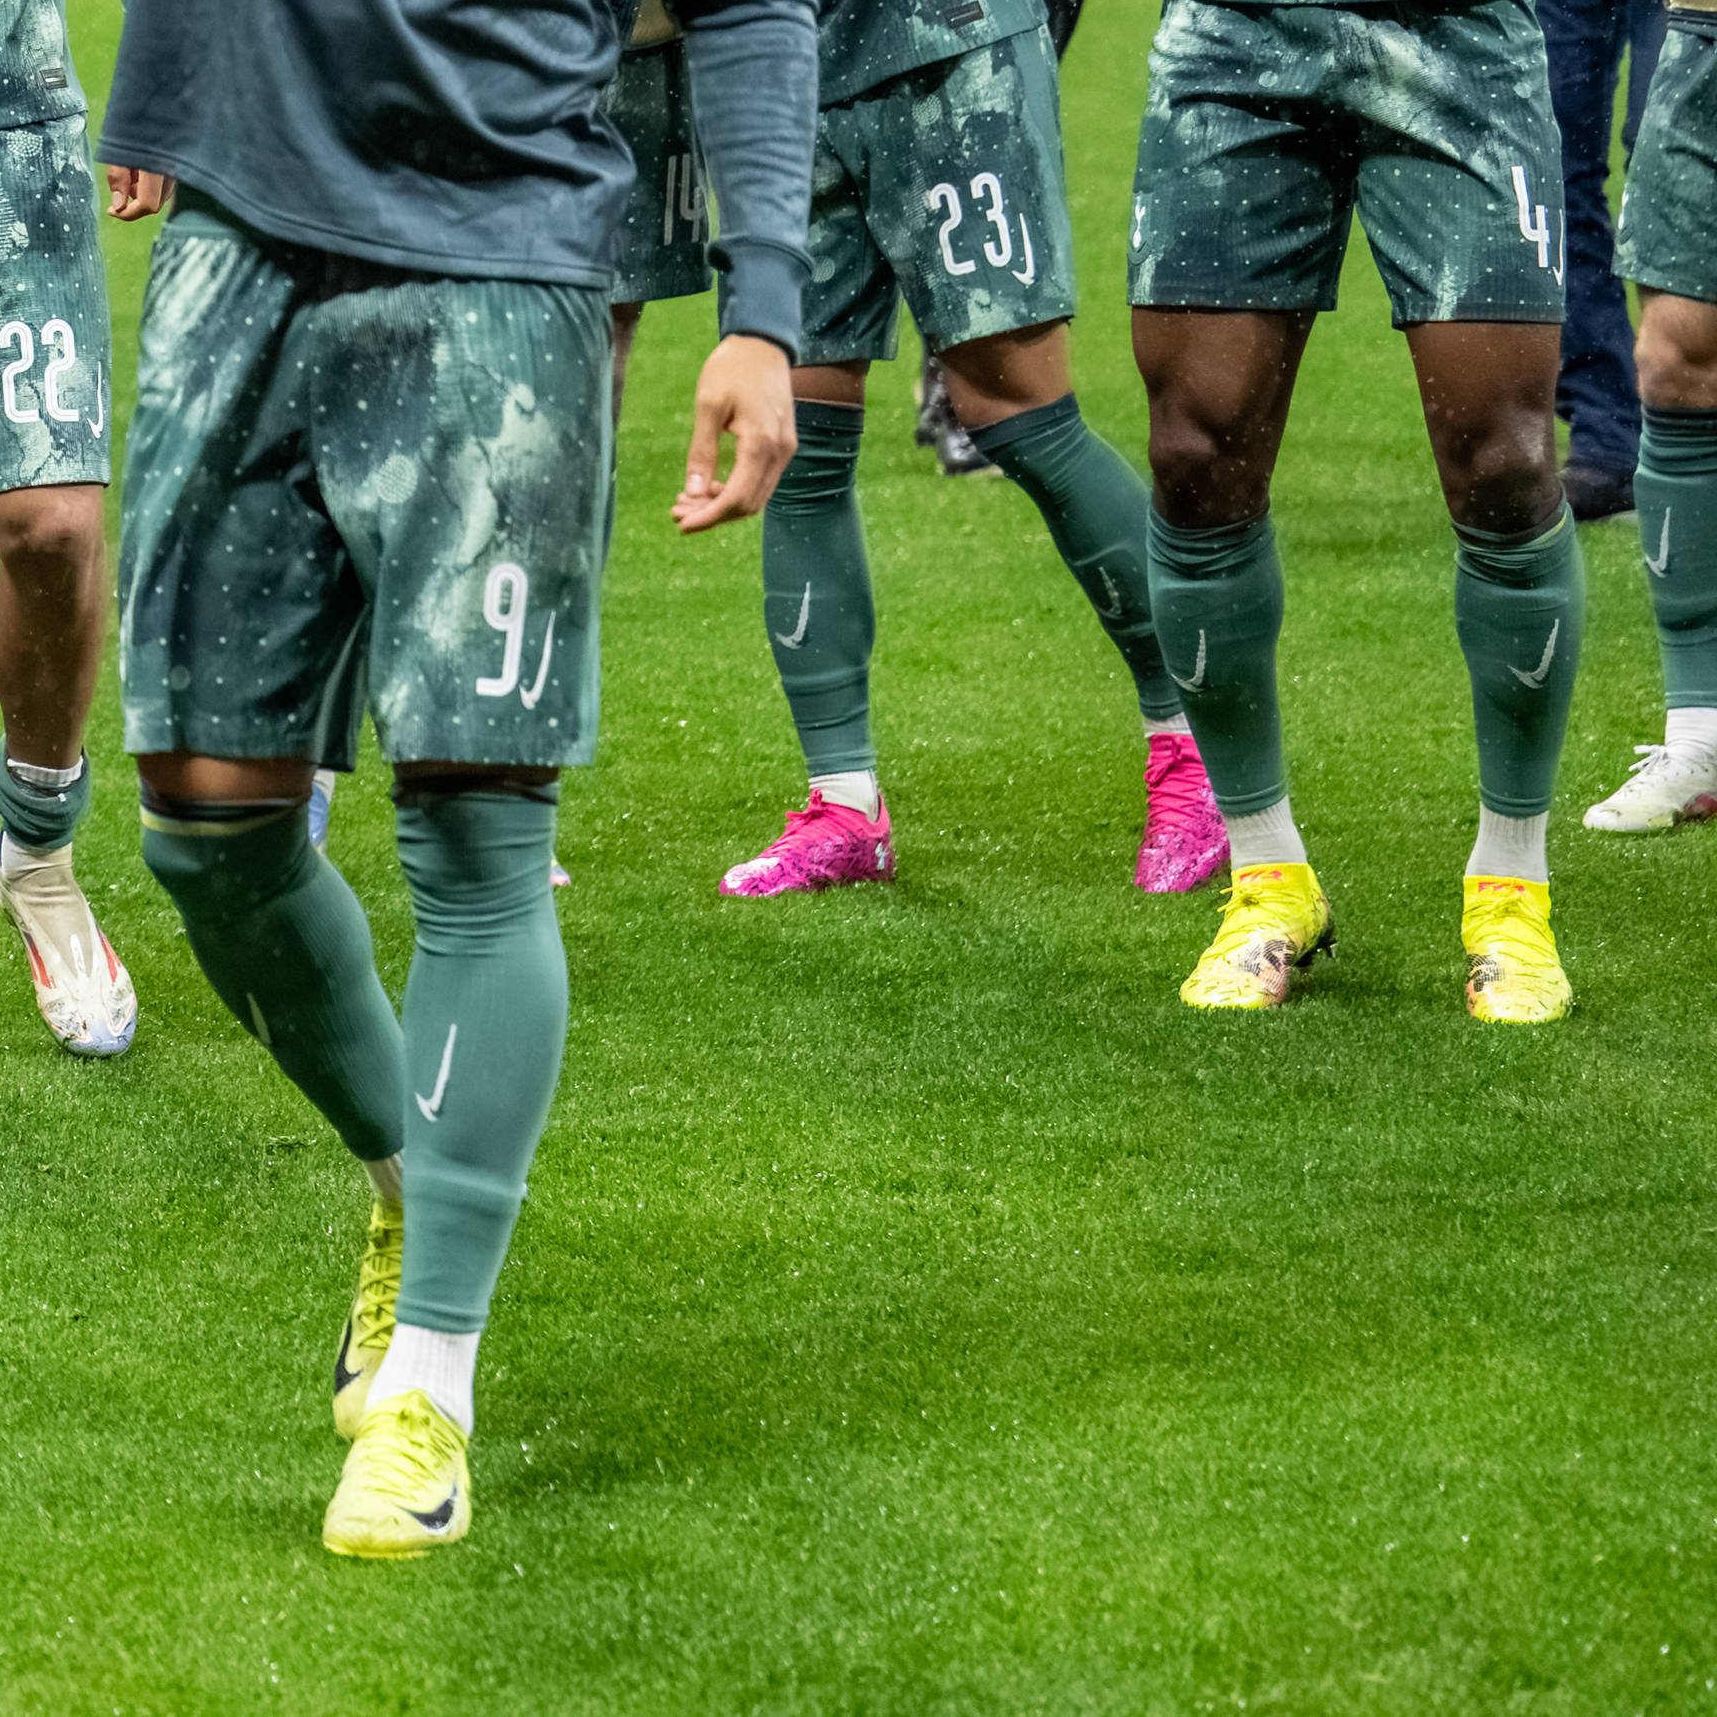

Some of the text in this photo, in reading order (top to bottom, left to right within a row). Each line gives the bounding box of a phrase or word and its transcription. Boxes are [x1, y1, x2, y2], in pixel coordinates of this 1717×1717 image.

[663, 152, 705, 247] 14
[928, 171, 1013, 277] 23
[1509, 165, 1552, 269] 4
[475, 563, 528, 698] 9
